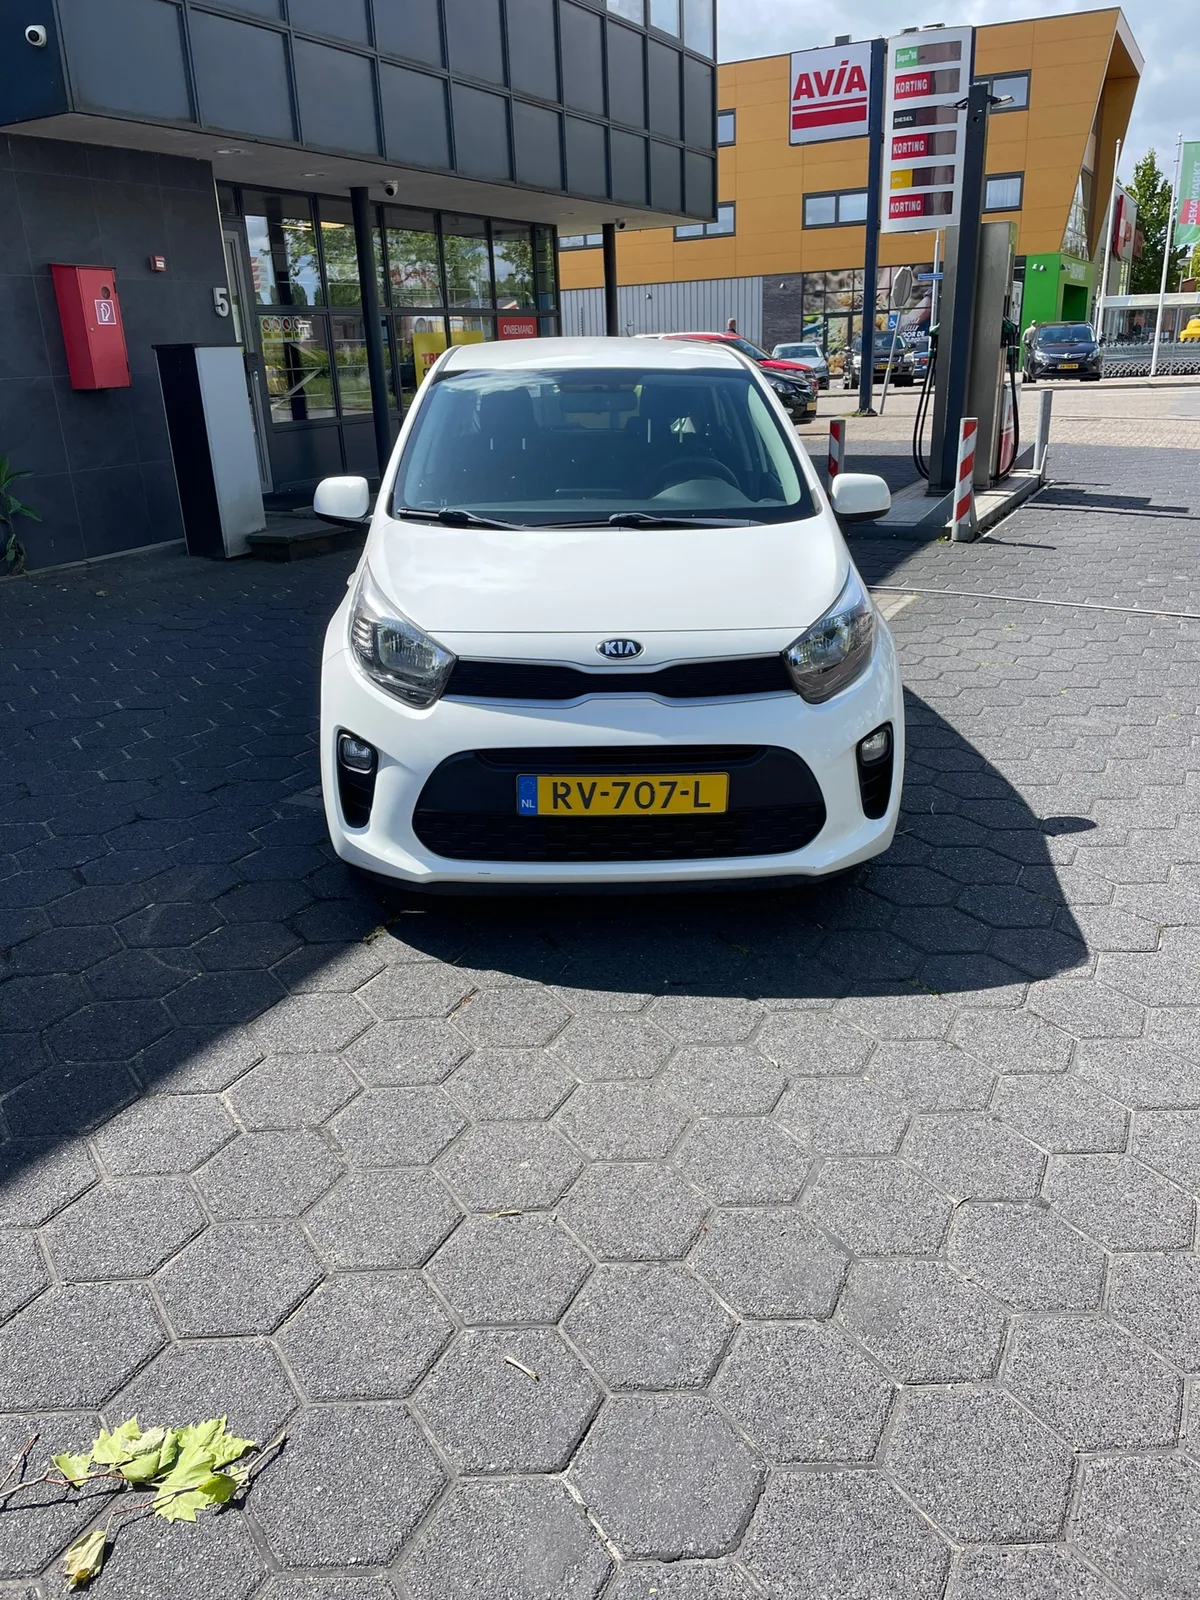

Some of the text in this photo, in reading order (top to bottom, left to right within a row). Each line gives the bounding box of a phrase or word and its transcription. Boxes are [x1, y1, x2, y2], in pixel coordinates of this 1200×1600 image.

[792, 60, 867, 101] AVIA
[895, 79, 928, 94] KORTING
[894, 115, 914, 124] DIESEL
[892, 139, 925, 155] KORTING
[890, 200, 922, 214] KORTING
[213, 287, 230, 317] 5
[502, 323, 534, 335] ONBEMAND
[604, 641, 637, 655] KIA
[521, 780, 711, 810] NL RV-707-L
